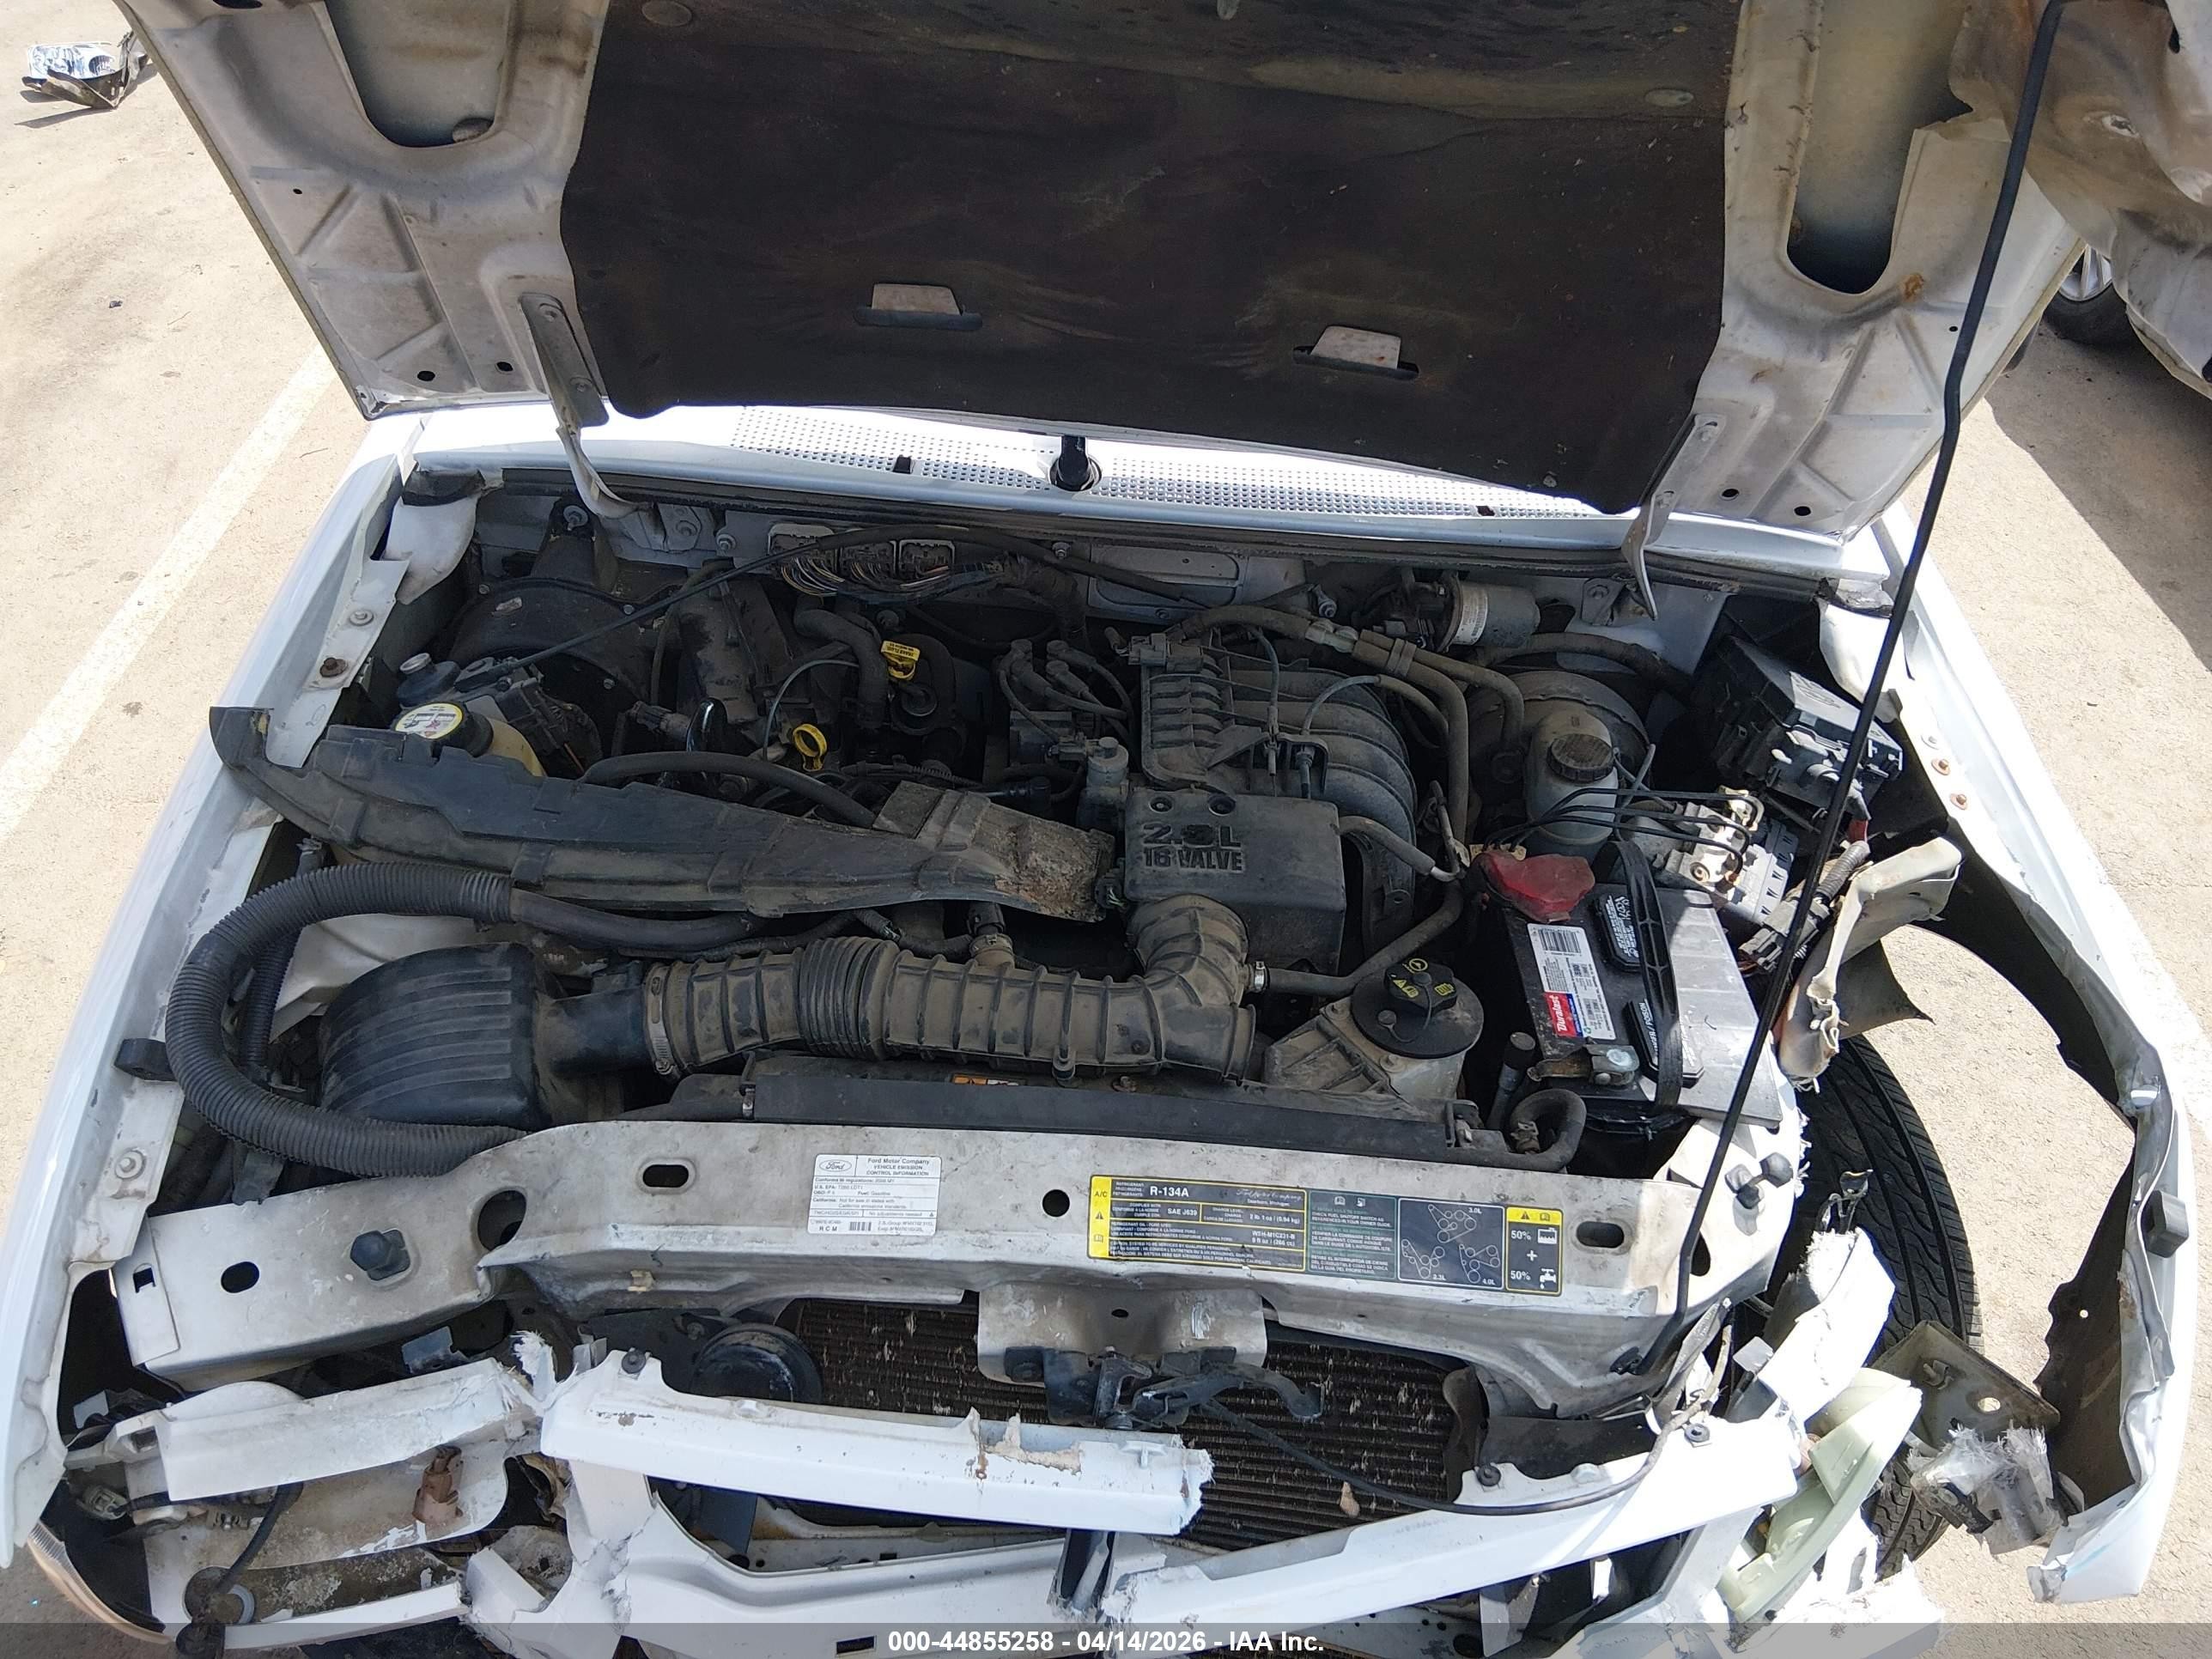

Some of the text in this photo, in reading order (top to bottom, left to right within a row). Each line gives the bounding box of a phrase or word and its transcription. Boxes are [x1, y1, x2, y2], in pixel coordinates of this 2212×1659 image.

[1144, 846, 1243, 872] 16 VALVE
[1549, 994, 1568, 1032] Duralast
[1638, 1002, 1654, 1026] POISON
[825, 1161, 845, 1170] Ford
[1150, 1186, 1189, 1197] R-134A
[1510, 1230, 1532, 1241] 50%
[1510, 1270, 1531, 1280] 50%
